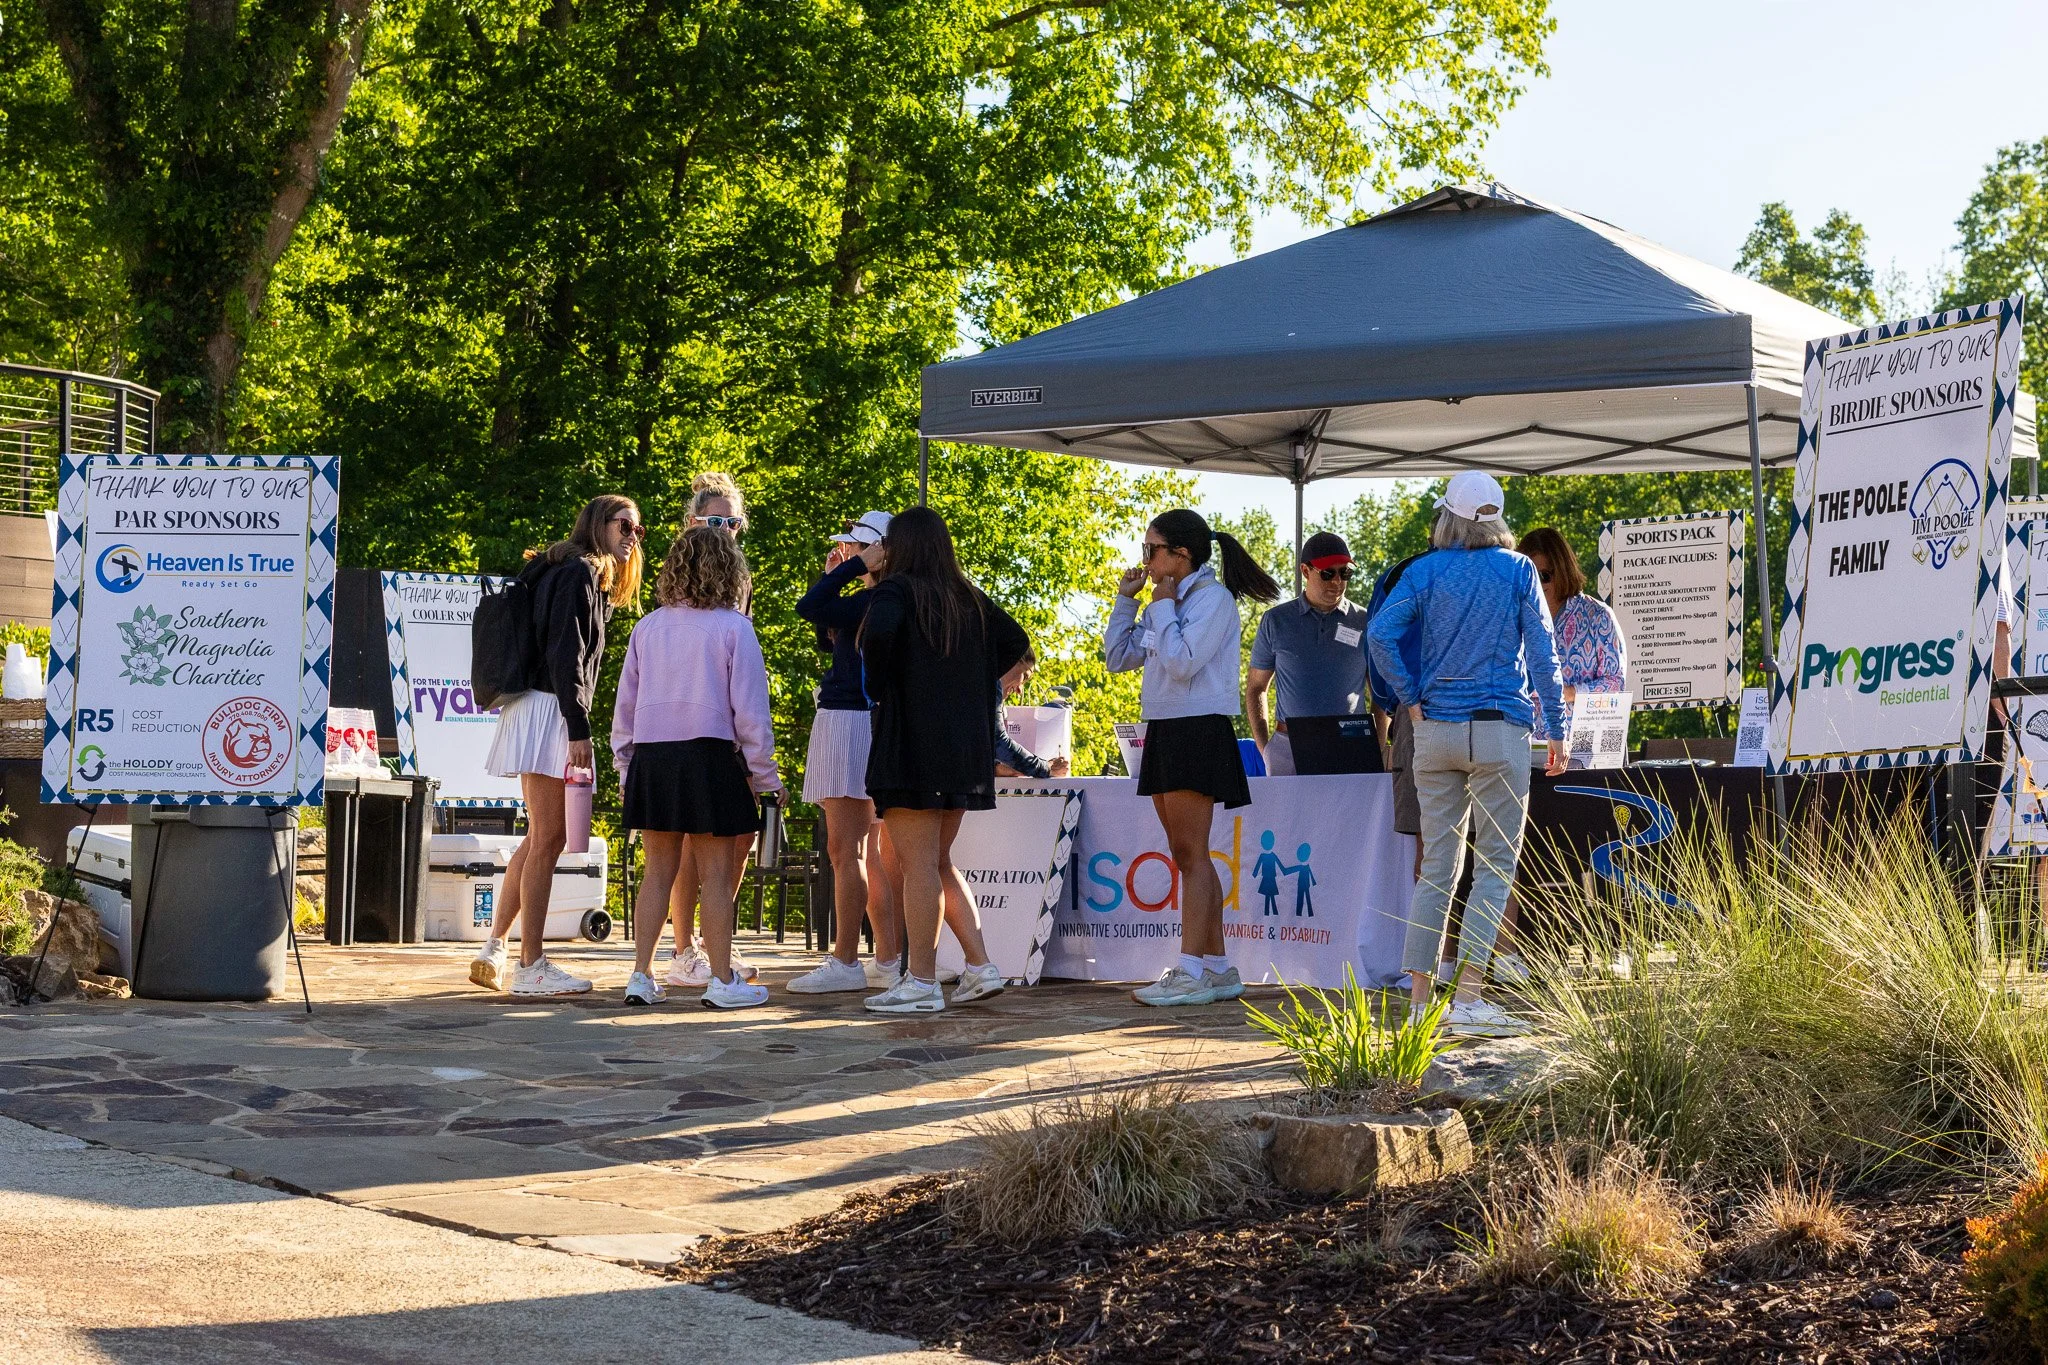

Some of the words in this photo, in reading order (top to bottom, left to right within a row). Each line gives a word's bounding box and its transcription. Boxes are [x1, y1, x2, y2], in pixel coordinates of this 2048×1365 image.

[1826, 354, 1884, 392] THANK
[1887, 346, 1922, 378] YOU
[1928, 339, 1954, 369] TO
[1958, 329, 1997, 364] OUR
[973, 389, 1040, 405] EVERBILT
[1829, 395, 1887, 428] BIRDIE
[1889, 376, 1984, 416] SPONSORS
[91, 476, 166, 500] THANK
[173, 477, 217, 500] YOU
[223, 477, 255, 499] TO
[262, 477, 309, 500] OUR
[1818, 490, 1851, 524] THE
[1852, 480, 1909, 519] POOLE
[114, 510, 156, 528] PAR
[163, 510, 280, 530] SPONSORS
[1911, 516, 1932, 536] JIM
[1933, 510, 1975, 532] POOLE
[1626, 530, 1678, 546] SPORTS
[1680, 526, 1716, 541] PACK
[147, 552, 225, 572] Heaven
[228, 553, 244, 572] Is
[248, 553, 295, 573] True
[1623, 555, 1667, 568] PACKAGE
[1668, 552, 1717, 564] INCLUDES:
[1829, 540, 1890, 578] FAMILY
[182, 580, 215, 589] Ready
[1626, 573, 1655, 581] MULLIGAN
[1627, 582, 1648, 590] RAFFLE
[1645, 589, 1667, 597] DOLLAR
[1668, 587, 1698, 595] SHOOTOUT
[401, 587, 441, 603] THANK
[445, 589, 469, 604] YOU
[1666, 596, 1681, 604] GOLF
[174, 605, 268, 630] Southern
[412, 609, 454, 621] COOLER
[1632, 607, 1657, 615] LONGEST
[1631, 632, 1656, 641] CLOSEST
[1653, 640, 1681, 648] Rivermont
[165, 634, 275, 666] Magnolia
[1655, 657, 1680, 665] CONTEST
[172, 662, 265, 687] Charities
[1652, 666, 1681, 674] Rivermont
[412, 678, 427, 686] FOR
[1645, 687, 1673, 696] PRICE:
[1673, 686, 1689, 695] $50
[1880, 684, 1950, 707] Residential
[413, 687, 500, 722] rya
[77, 709, 114, 733] R5
[132, 710, 163, 720] COST
[210, 701, 261, 730] BULLDOG
[263, 705, 286, 731] FIRM
[131, 723, 201, 733] REDUCTION
[123, 759, 173, 769] HOLODY
[175, 762, 203, 771] group
[209, 752, 234, 778] INJURY
[235, 752, 284, 782] ATTORNEYS
[958, 869, 1047, 885] ISTRATION
[974, 895, 1008, 909] BLE
[1058, 923, 1110, 938] INNOVATIVE
[1113, 923, 1169, 938] SOLUTIONS
[1172, 923, 1183, 938] FO
[1222, 923, 1265, 940] VANTAGE
[1267, 926, 1276, 940] &
[1280, 926, 1331, 945] DISABILITY
